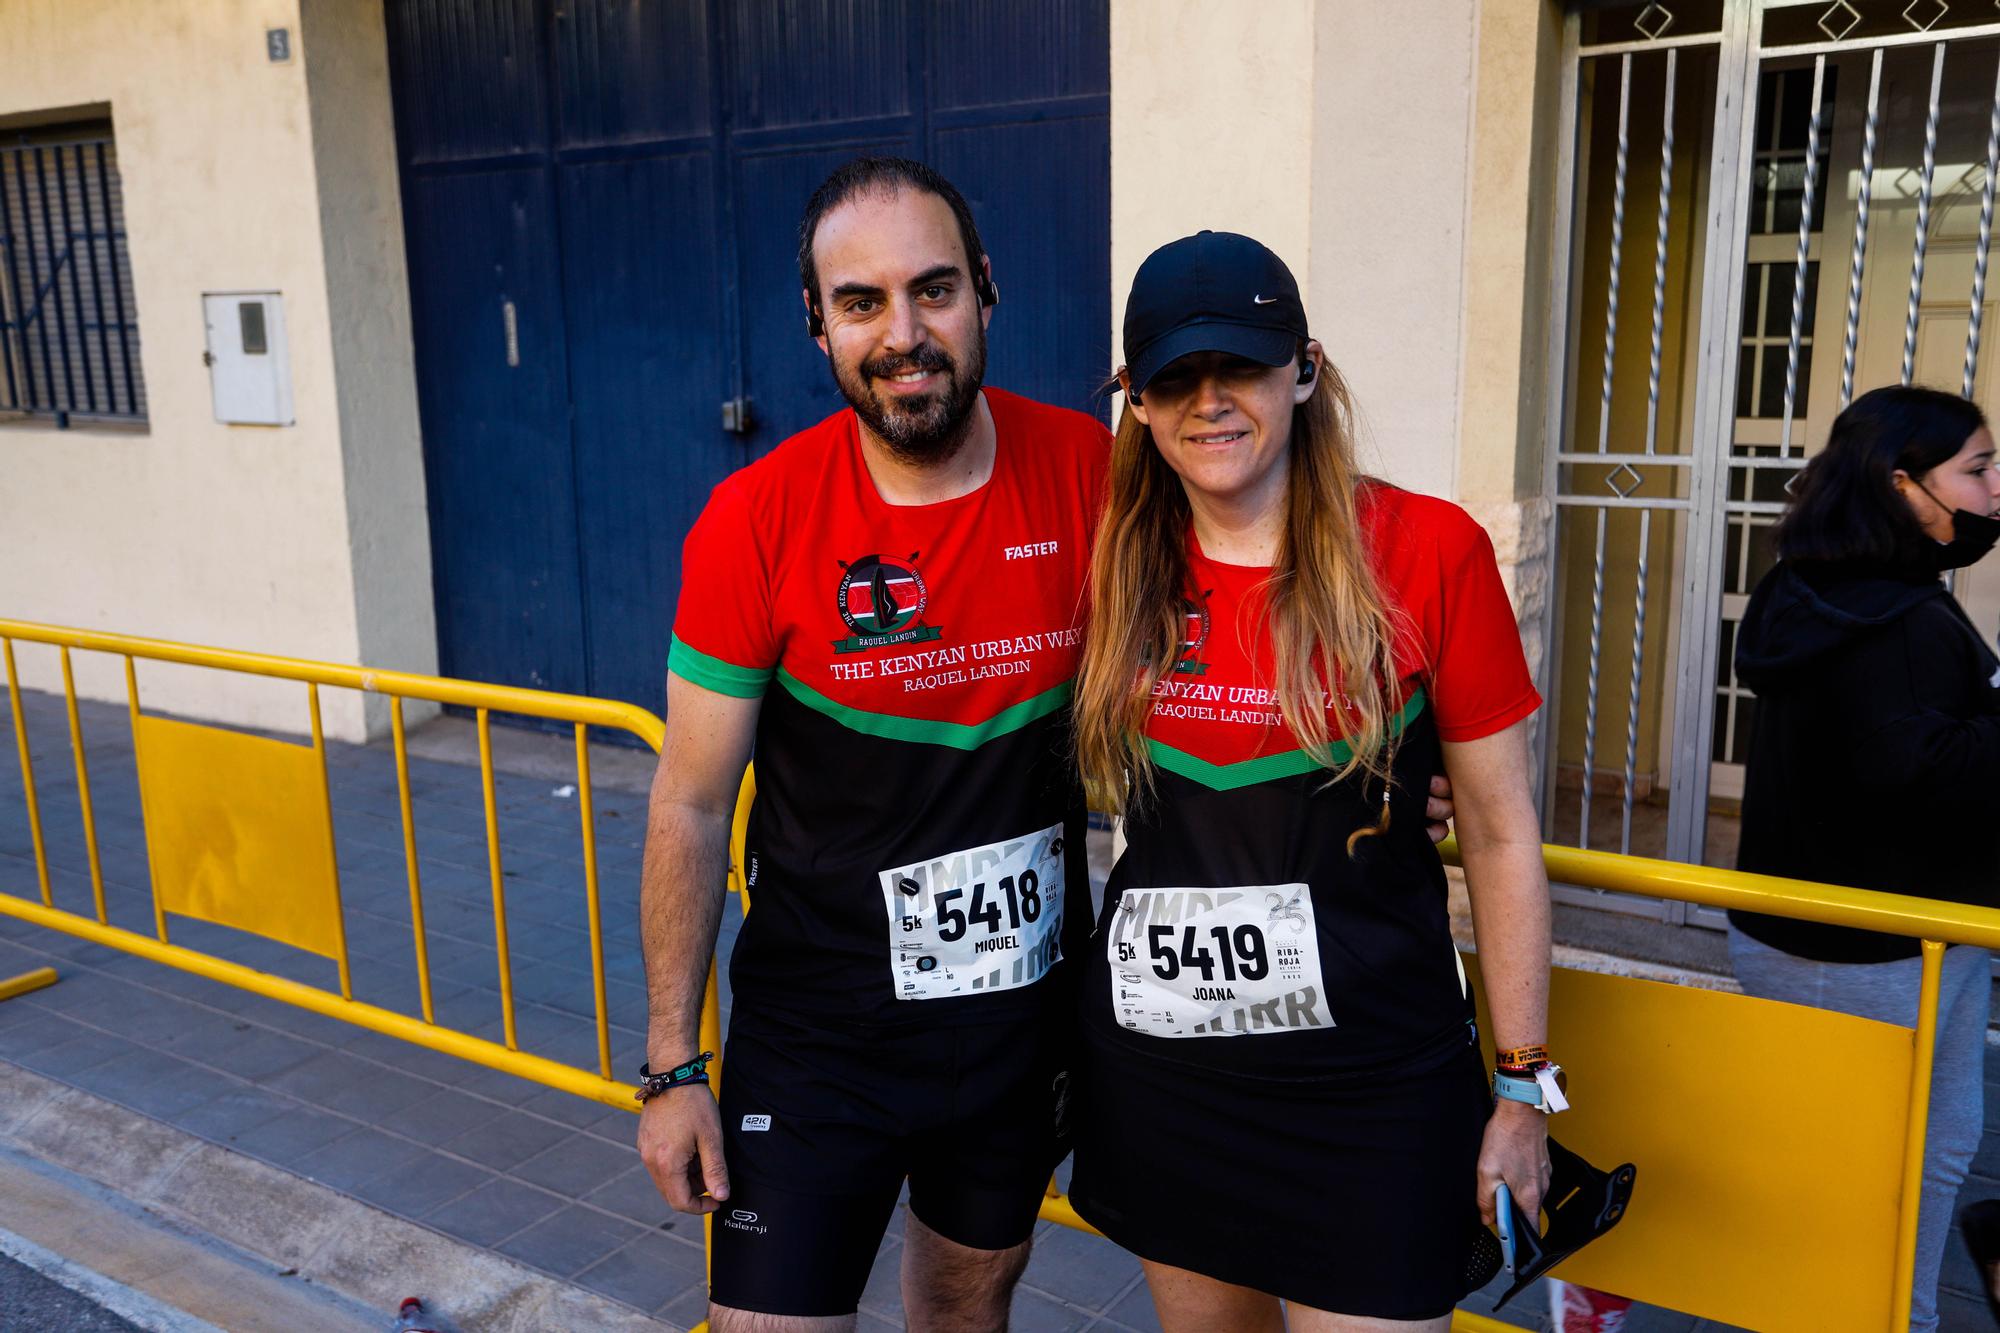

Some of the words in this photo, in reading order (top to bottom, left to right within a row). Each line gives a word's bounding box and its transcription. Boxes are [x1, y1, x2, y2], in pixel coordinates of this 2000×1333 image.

[1004, 540, 1058, 560] FASTER
[839, 573, 852, 608] KENYAN
[911, 569, 927, 595] URBAN
[917, 596, 927, 615] WAY
[842, 611, 855, 627] THE
[858, 637, 888, 646] RAQUEL
[890, 630, 917, 643] LANDIN
[830, 661, 874, 682] THE
[880, 647, 966, 676] KENYAN
[971, 634, 1043, 661] URBAN
[1045, 626, 1084, 647] WAY
[903, 670, 967, 692] RAQUEL
[970, 659, 1031, 679] LANDIN
[1150, 681, 1223, 700] ENYAN
[1228, 686, 1283, 705] URBA
[1154, 703, 1217, 721] RAQUEL
[1220, 709, 1283, 726] LANDIN
[748, 857, 758, 886] FASTER
[933, 869, 1041, 943] 5418
[974, 935, 1020, 954] MIQUEL
[1148, 923, 1269, 982] 5419
[1277, 948, 1304, 957] RIBA-
[1192, 987, 1236, 1002] JOANA
[745, 1117, 767, 1125] 42K
[724, 1218, 768, 1235] Kalenji
